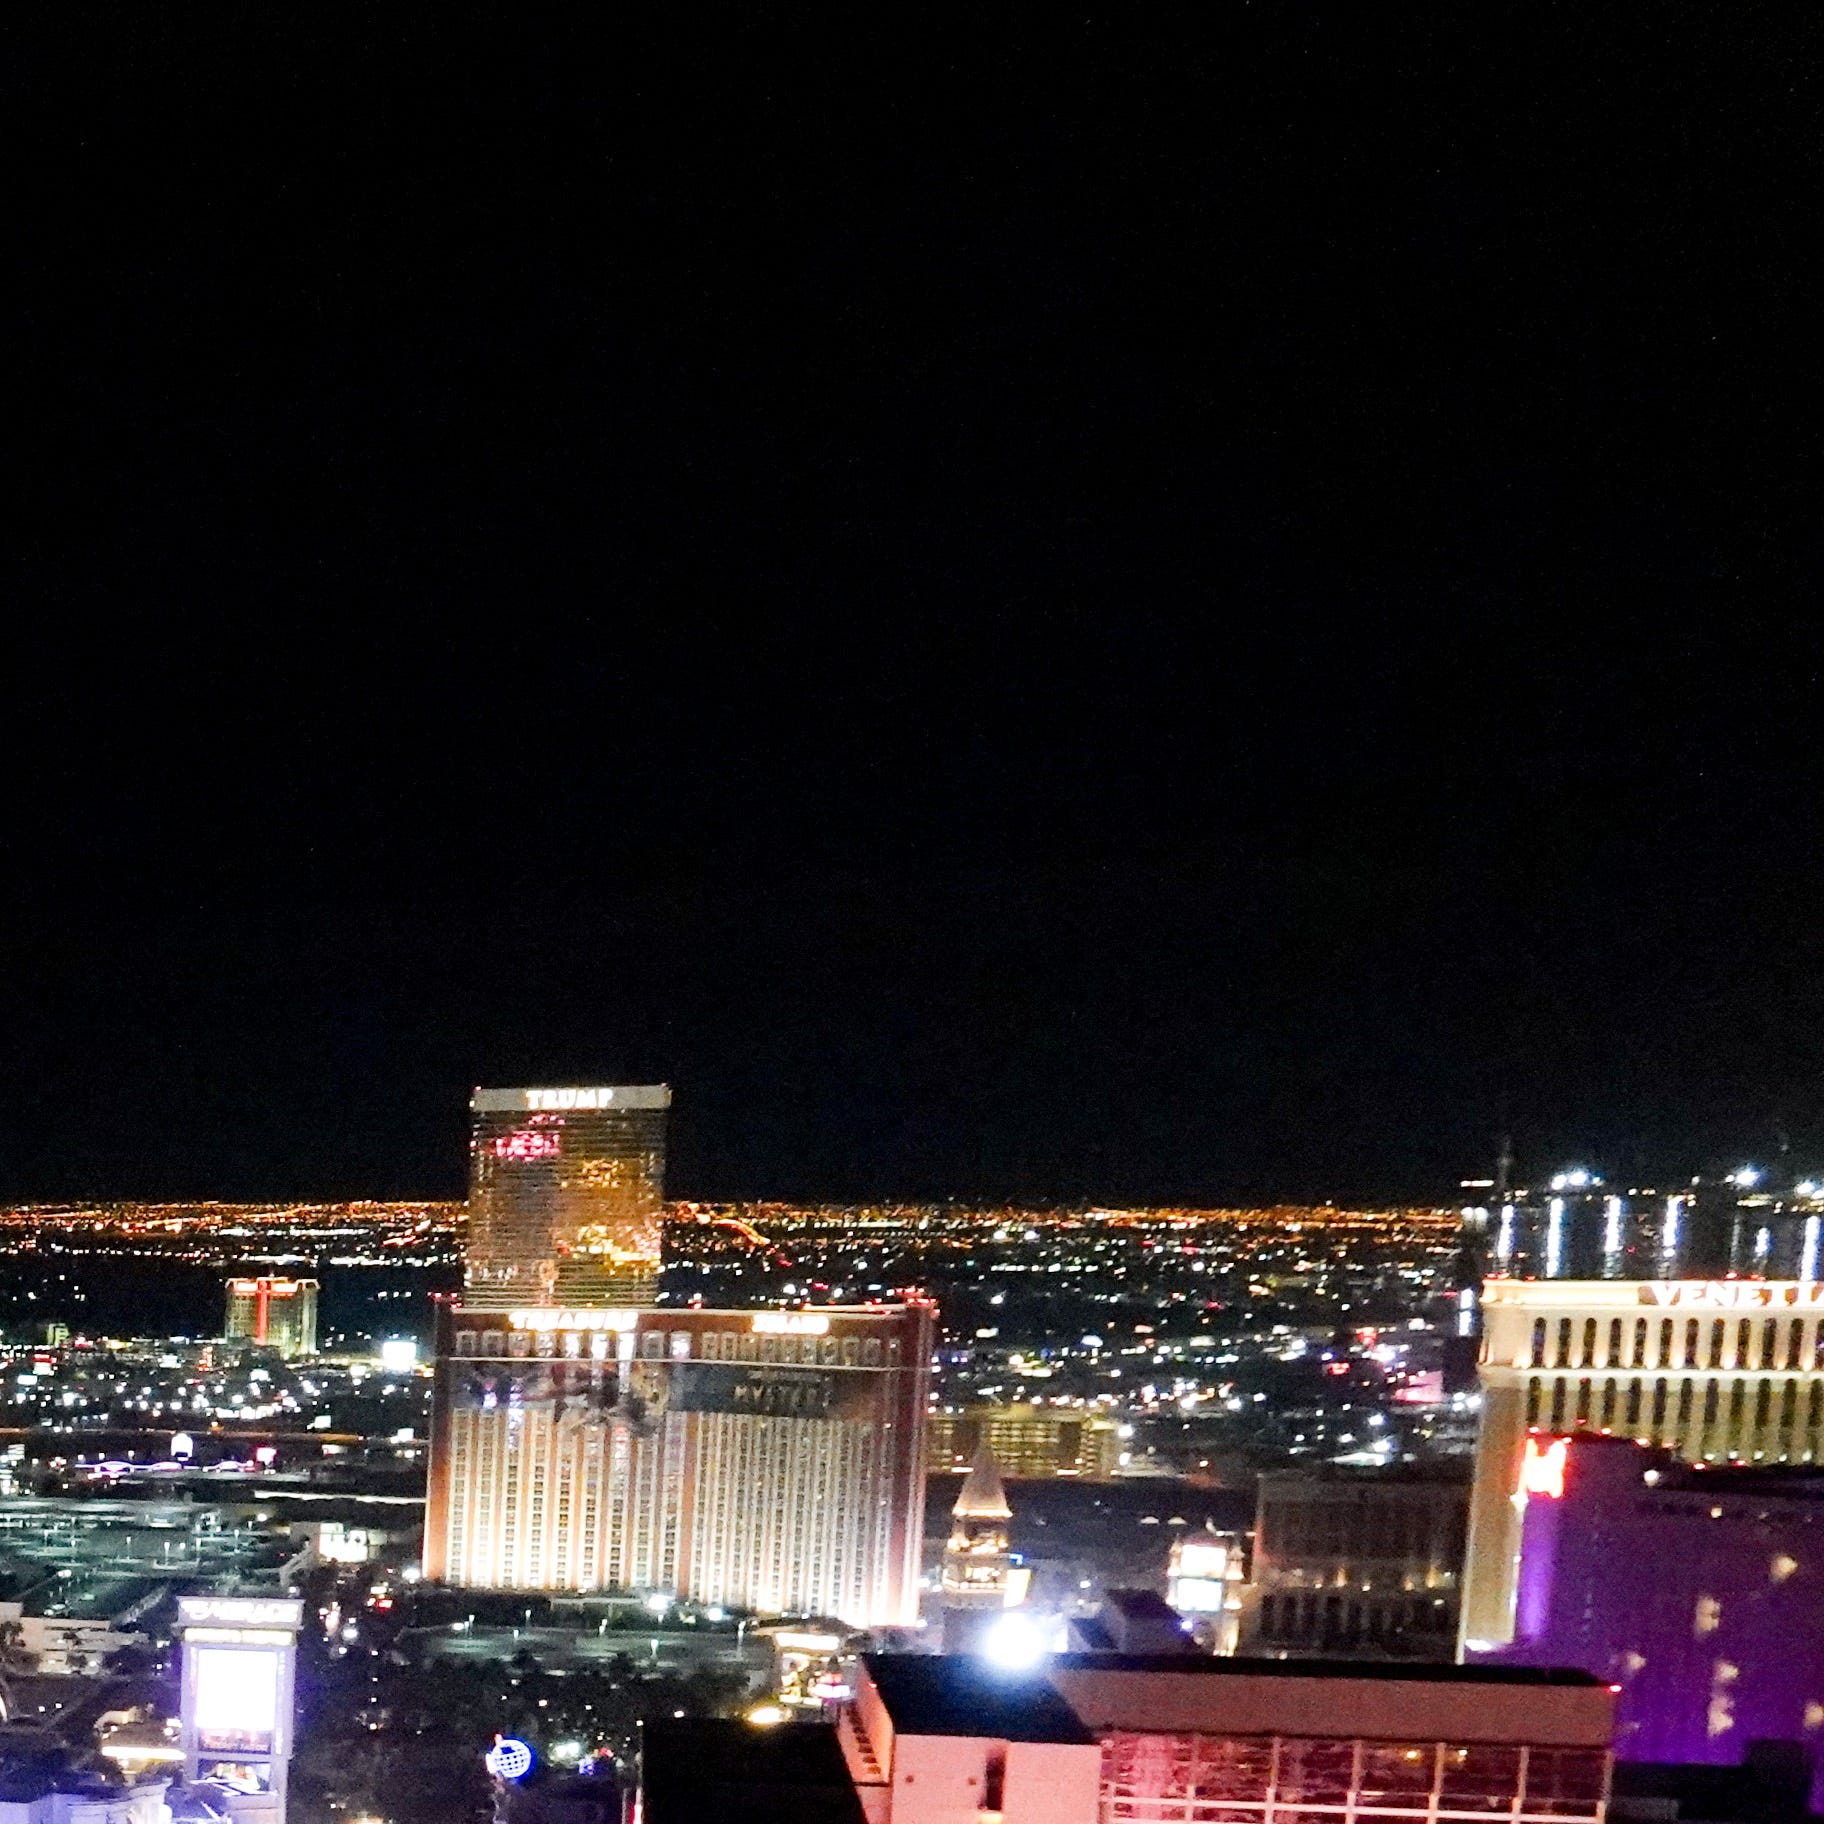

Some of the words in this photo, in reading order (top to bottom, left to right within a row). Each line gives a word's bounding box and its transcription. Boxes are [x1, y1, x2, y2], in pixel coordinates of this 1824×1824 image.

[526, 1089, 614, 1109] TRUMP
[1638, 1280, 1824, 1307] VENETI
[508, 1312, 639, 1331] TREASURE
[751, 1316, 830, 1335] ISLAND
